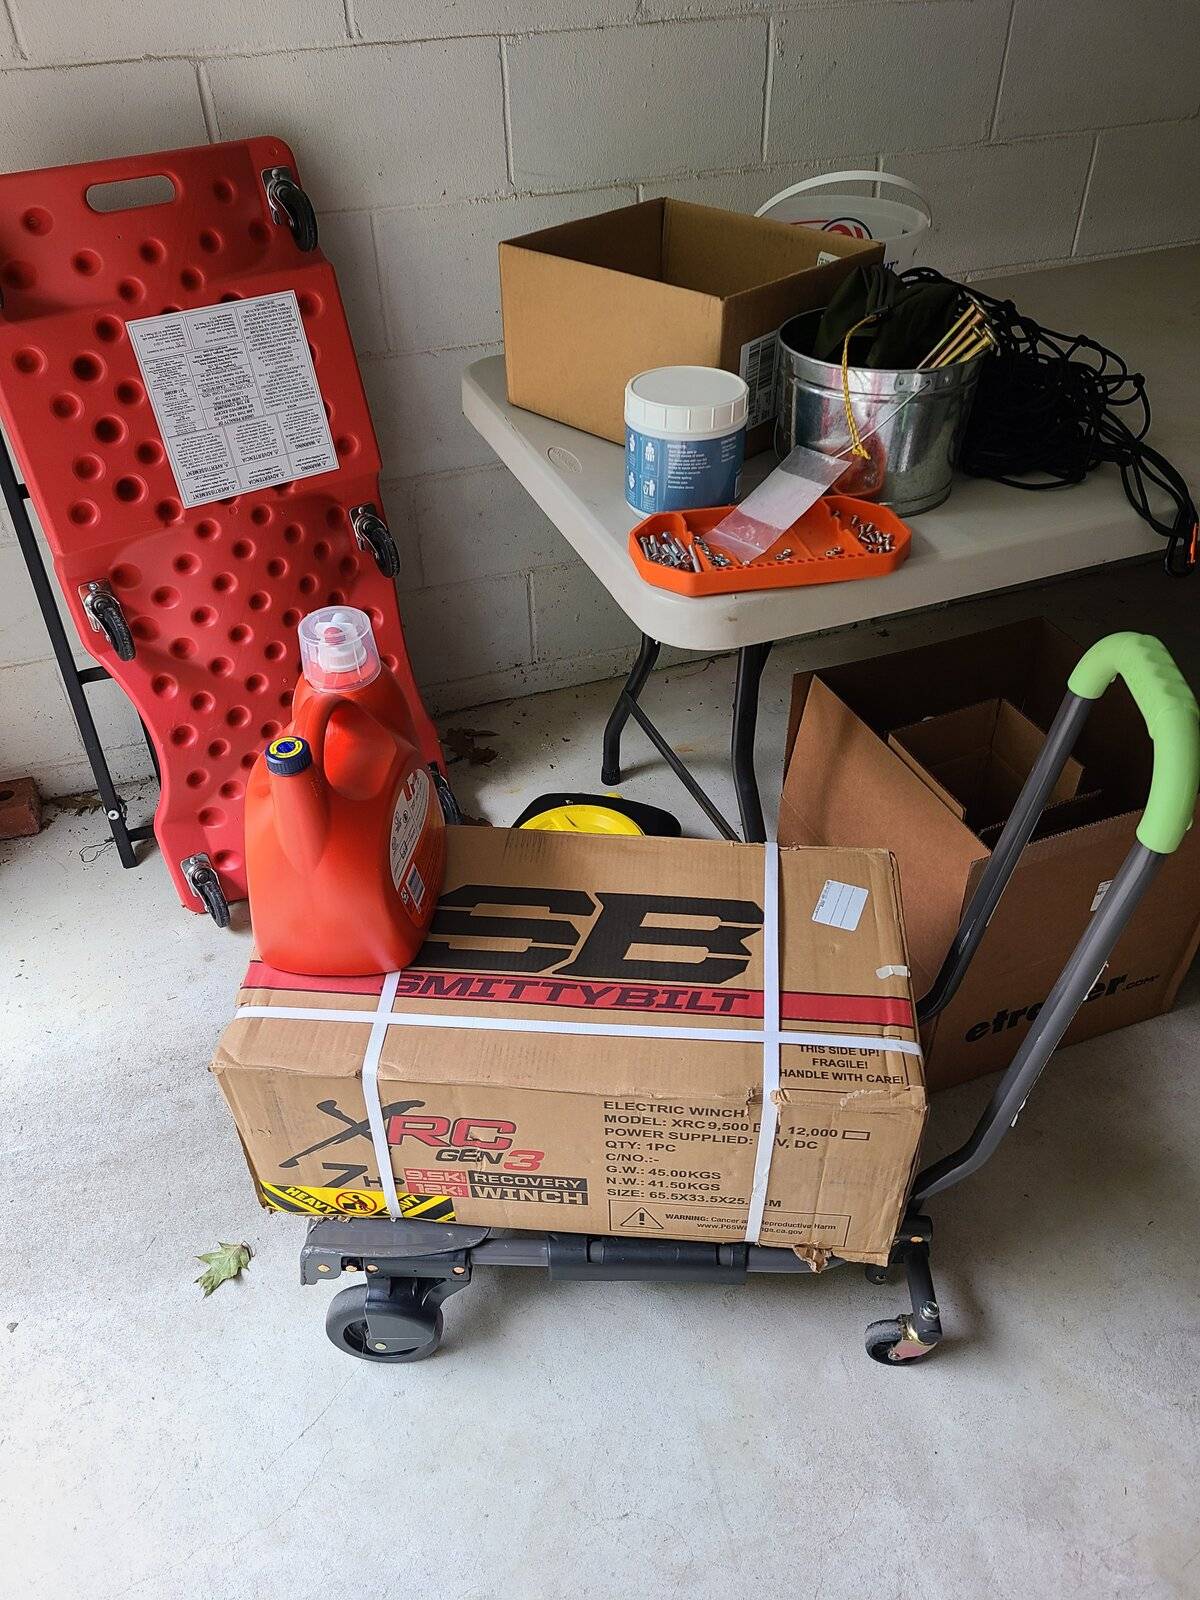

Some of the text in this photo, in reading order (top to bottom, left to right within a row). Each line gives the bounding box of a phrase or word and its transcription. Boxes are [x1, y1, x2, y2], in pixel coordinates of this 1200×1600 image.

[241, 450, 273, 462] ADVERTENCIA
[184, 463, 223, 476] AVERTISSEMENT
[247, 472, 279, 484] ADVERTENCIA
[192, 486, 229, 499] AVERTISSEMENT
[382, 974, 750, 1013] SMITTYBILT
[965, 974, 1155, 1043] etraer.com
[800, 1045, 880, 1057] THIS SIDE UP!
[812, 1058, 868, 1069] FRAGILE!
[779, 1069, 904, 1084] HANDLE WITH CARE!
[604, 1101, 745, 1118] ELECTRIC WINCH
[604, 1114, 667, 1126] MODEL:
[788, 1126, 838, 1138] 12,000
[279, 1100, 517, 1168] XRC
[604, 1128, 663, 1139] POWER
[669, 1132, 753, 1144] SUPPLIED:
[795, 1140, 818, 1149] DC
[605, 1141, 676, 1152] QTY: 1PC
[435, 1148, 545, 1171] GEN 3
[605, 1153, 659, 1163] C/NO.:-
[322, 1162, 368, 1188] 7
[406, 1170, 460, 1183] 9.5K
[606, 1165, 721, 1180] G.W.: 45.00KGS
[474, 1174, 580, 1189] RECOVERY
[606, 1177, 720, 1191] N.W.: 41.50KGS
[415, 1184, 458, 1196] 12K
[475, 1186, 582, 1205] WINCH
[285, 1187, 337, 1214] HEAVY
[607, 1188, 782, 1208] SIZE: 65.5X33.5X25.M
[665, 1213, 709, 1222] WARNING:
